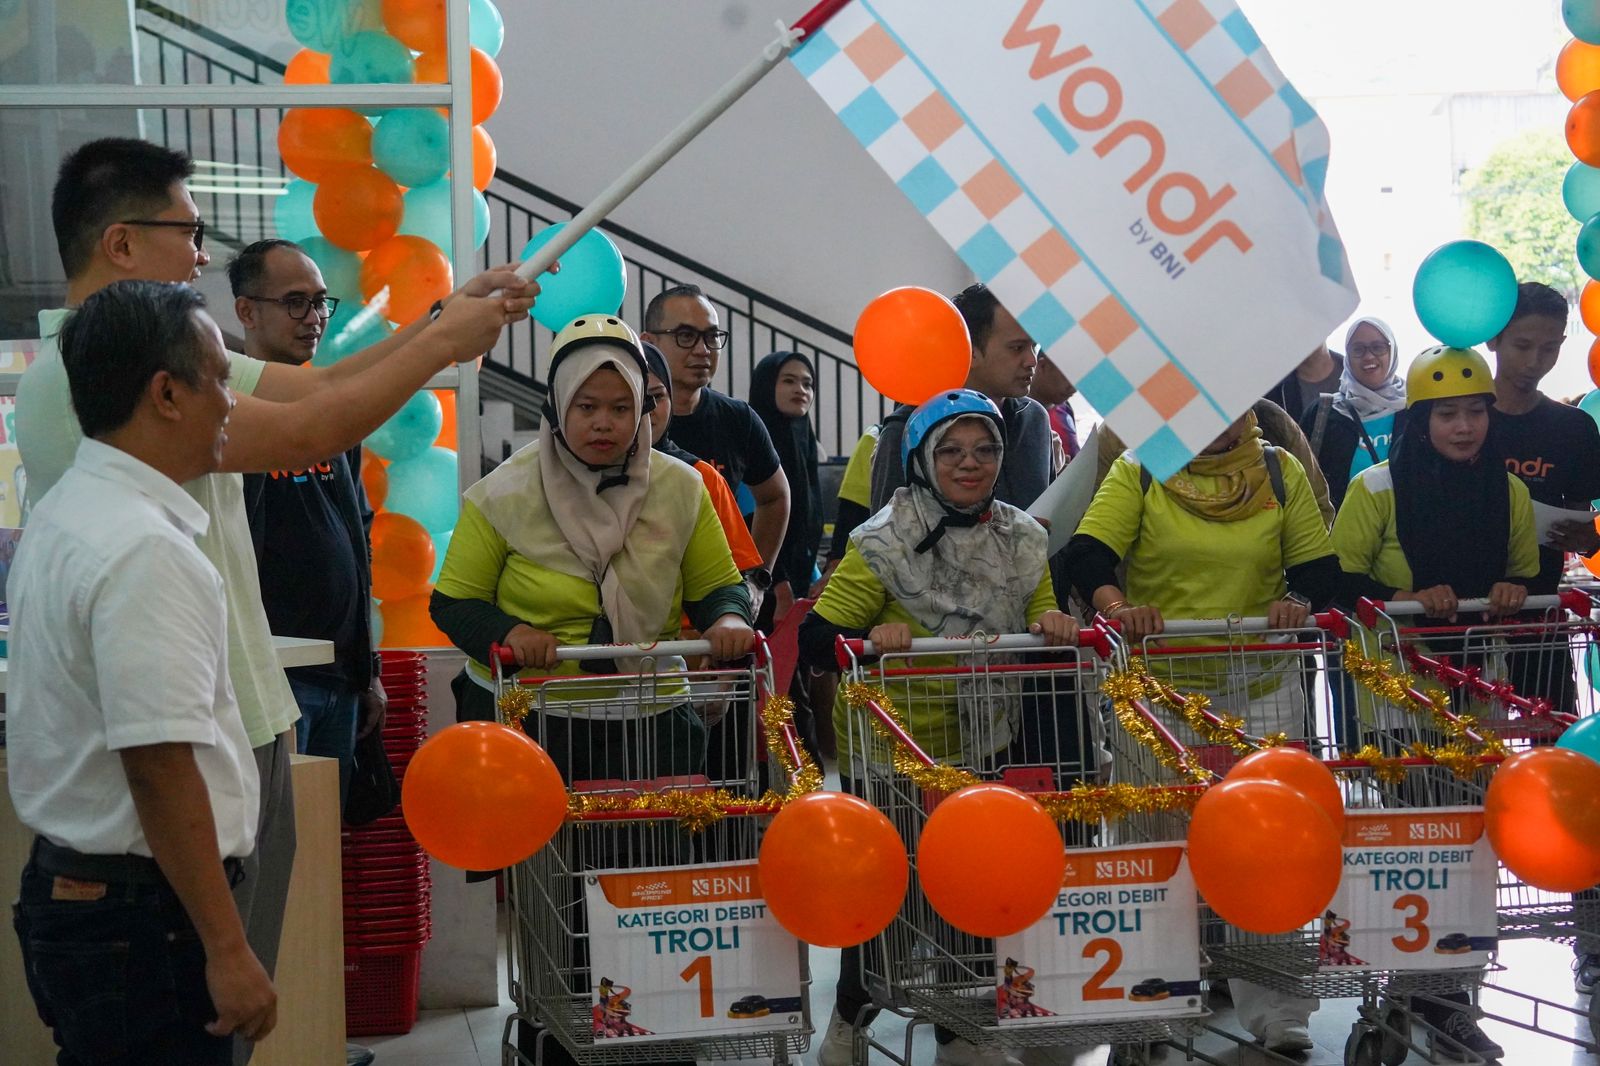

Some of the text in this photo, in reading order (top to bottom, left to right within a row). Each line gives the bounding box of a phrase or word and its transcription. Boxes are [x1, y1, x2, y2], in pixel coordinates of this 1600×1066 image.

[1001, 0, 1254, 264] wondr
[1129, 217, 1186, 280] by BNI
[1504, 456, 1555, 478] ndr
[1427, 822, 1461, 840] BNI
[1116, 859, 1153, 878] BNI
[1343, 850, 1474, 866] KATEGORI DEBIT
[713, 876, 750, 895] BNI
[1369, 868, 1449, 891] TROLI
[1057, 888, 1168, 907] EGORI DEBIT
[617, 905, 767, 928] KATEGORI DEBIT
[1052, 908, 1142, 936] TROLI
[1391, 893, 1431, 953] 3
[648, 926, 740, 954] TROLI
[1081, 937, 1125, 1002] 2
[680, 955, 715, 1018] 1
